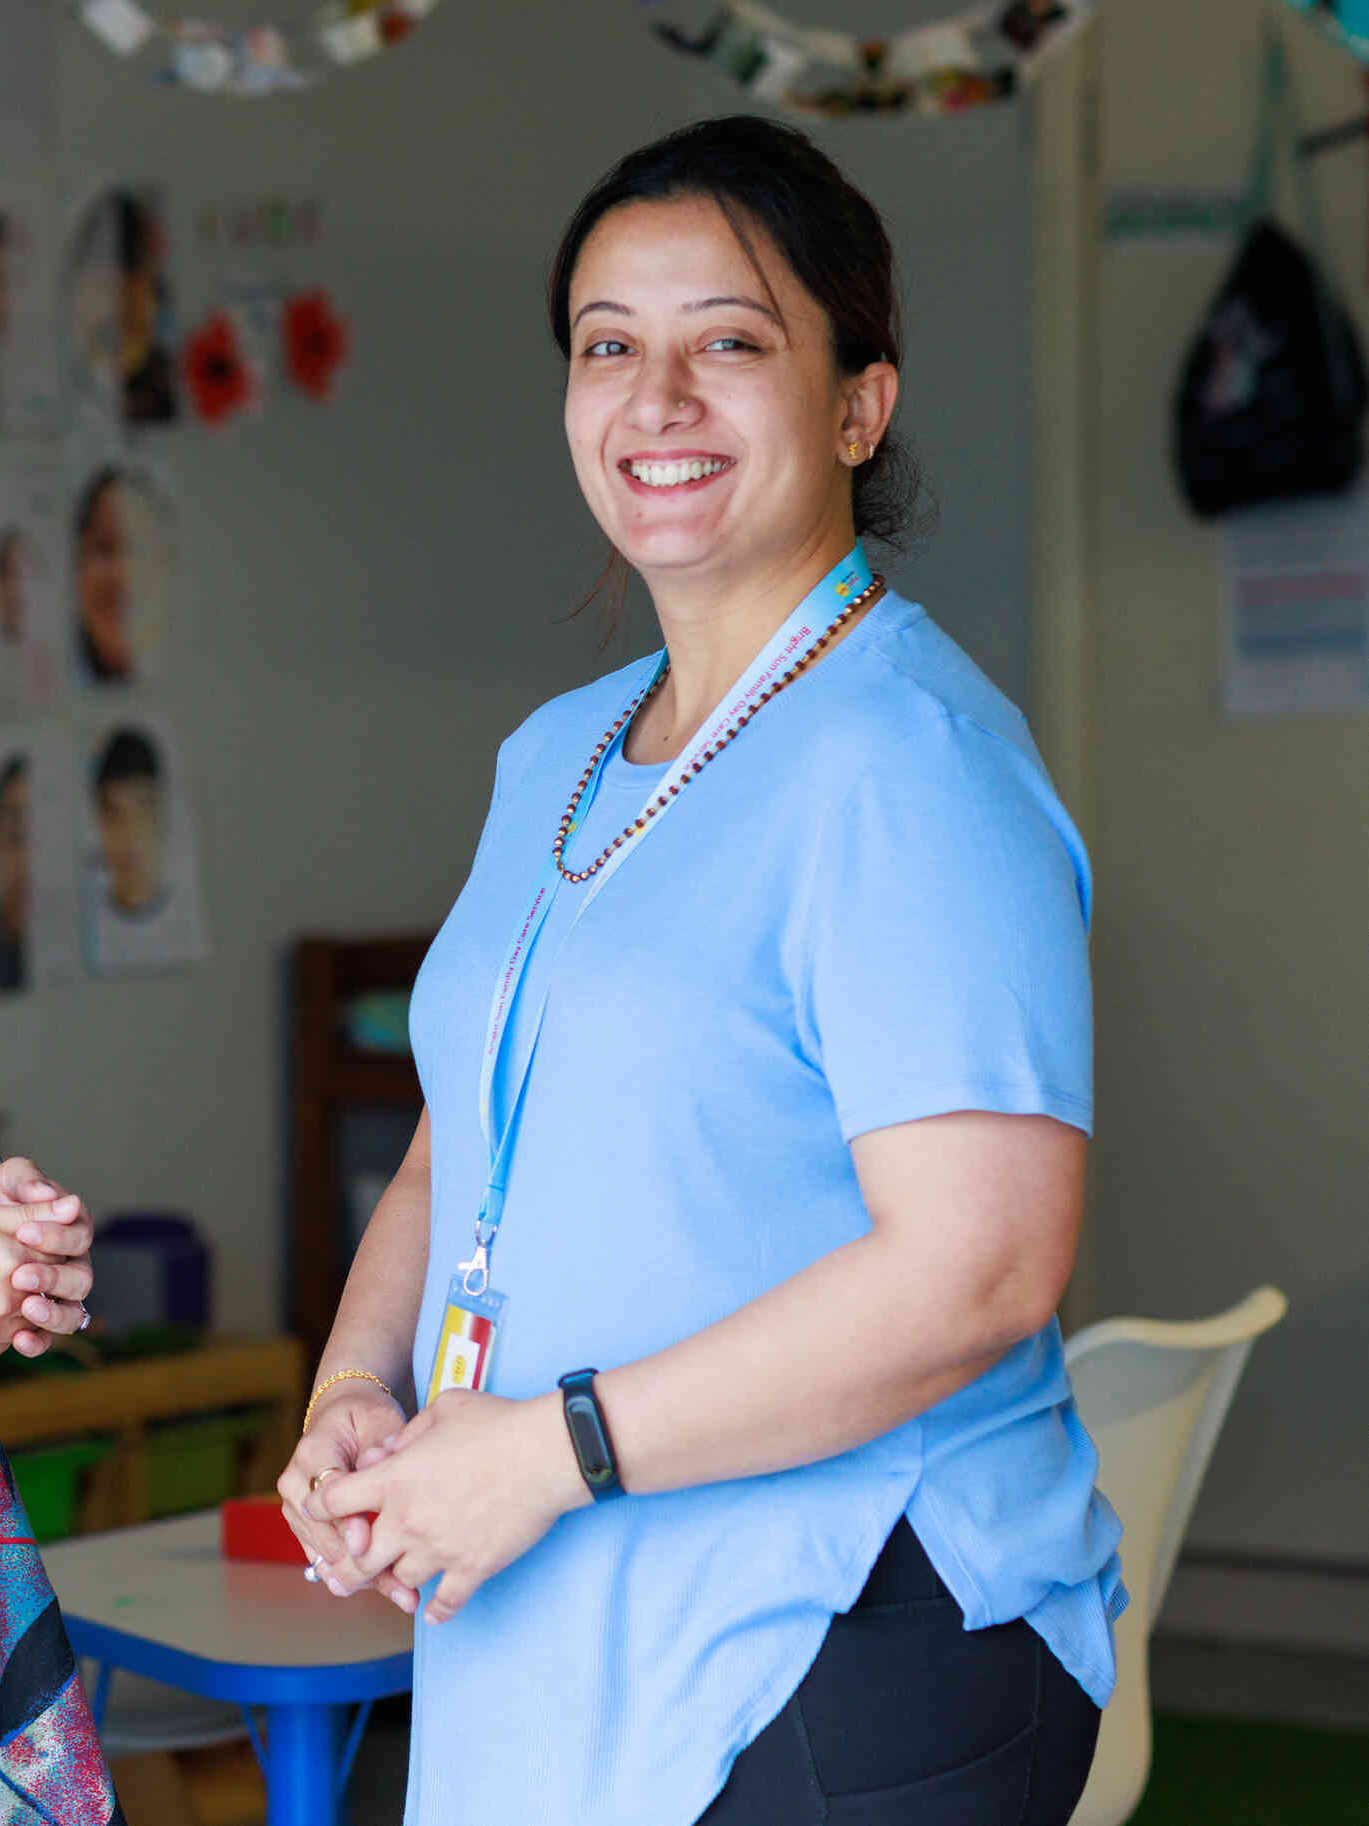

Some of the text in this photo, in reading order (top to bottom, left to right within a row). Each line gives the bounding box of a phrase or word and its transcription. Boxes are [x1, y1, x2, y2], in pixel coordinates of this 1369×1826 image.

[784, 626, 812, 654] Bright
[769, 654, 788, 673] Sun
[744, 672, 772, 700] Family
[729, 700, 747, 716] Day
[711, 717, 731, 738] Care
[516, 922, 530, 945] Care
